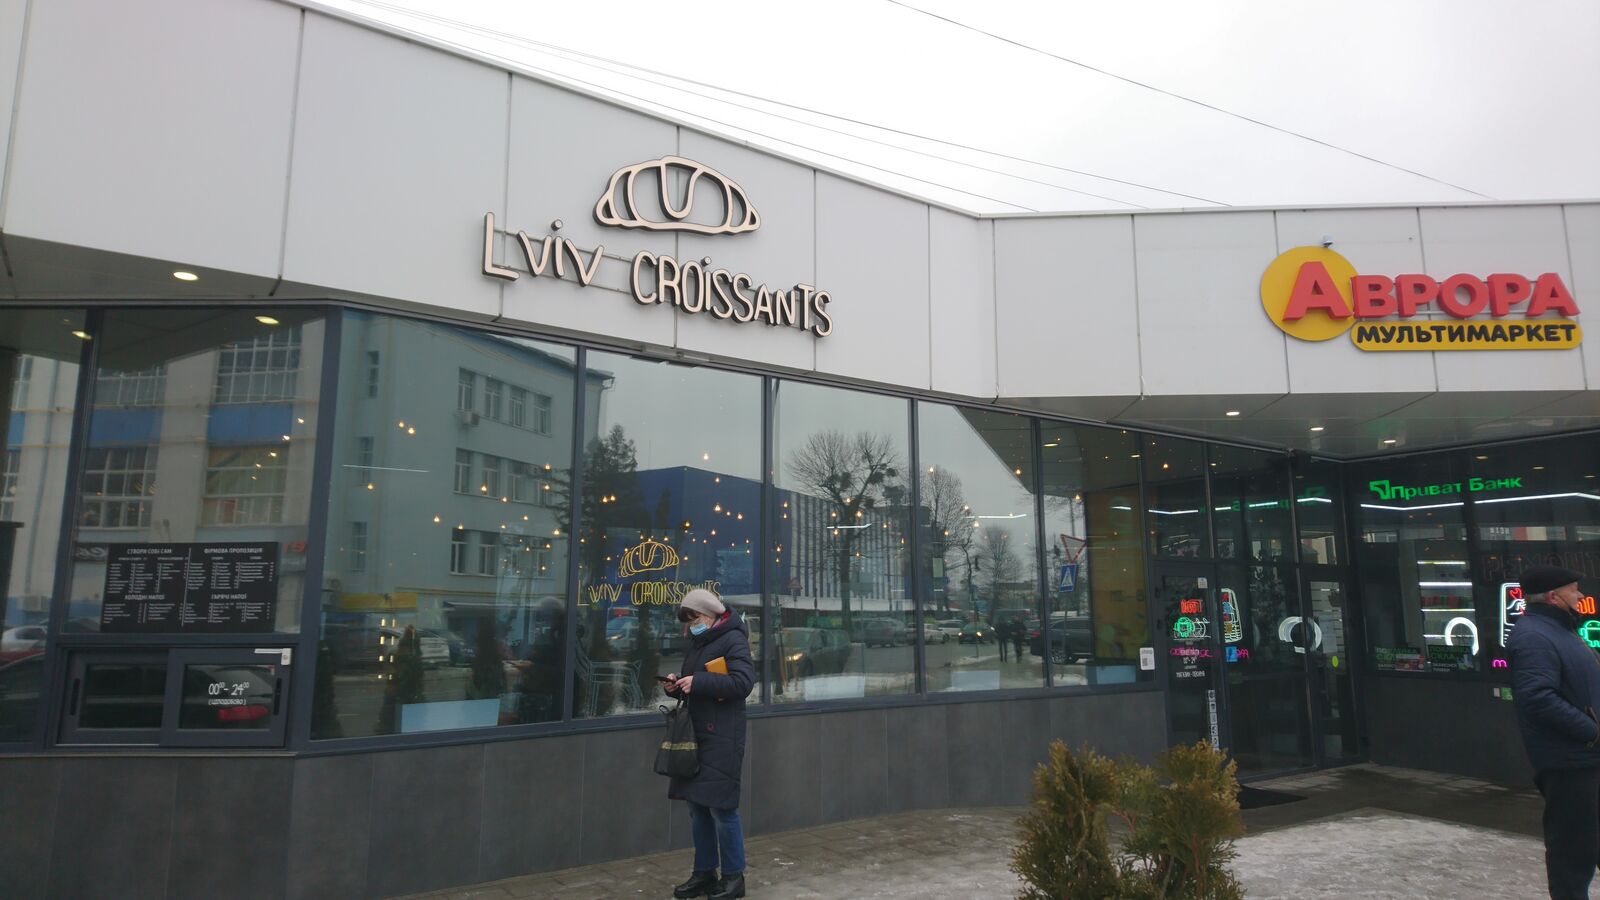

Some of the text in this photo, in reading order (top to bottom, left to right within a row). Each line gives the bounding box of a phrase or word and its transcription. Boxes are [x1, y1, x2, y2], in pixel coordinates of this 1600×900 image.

[631, 250, 833, 338] CROISSANTS
[1282, 261, 1581, 321] АВРОРА
[1356, 324, 1577, 344] МУЛЬТИМАРКЕТ
[1391, 477, 1522, 500] Приват Банк
